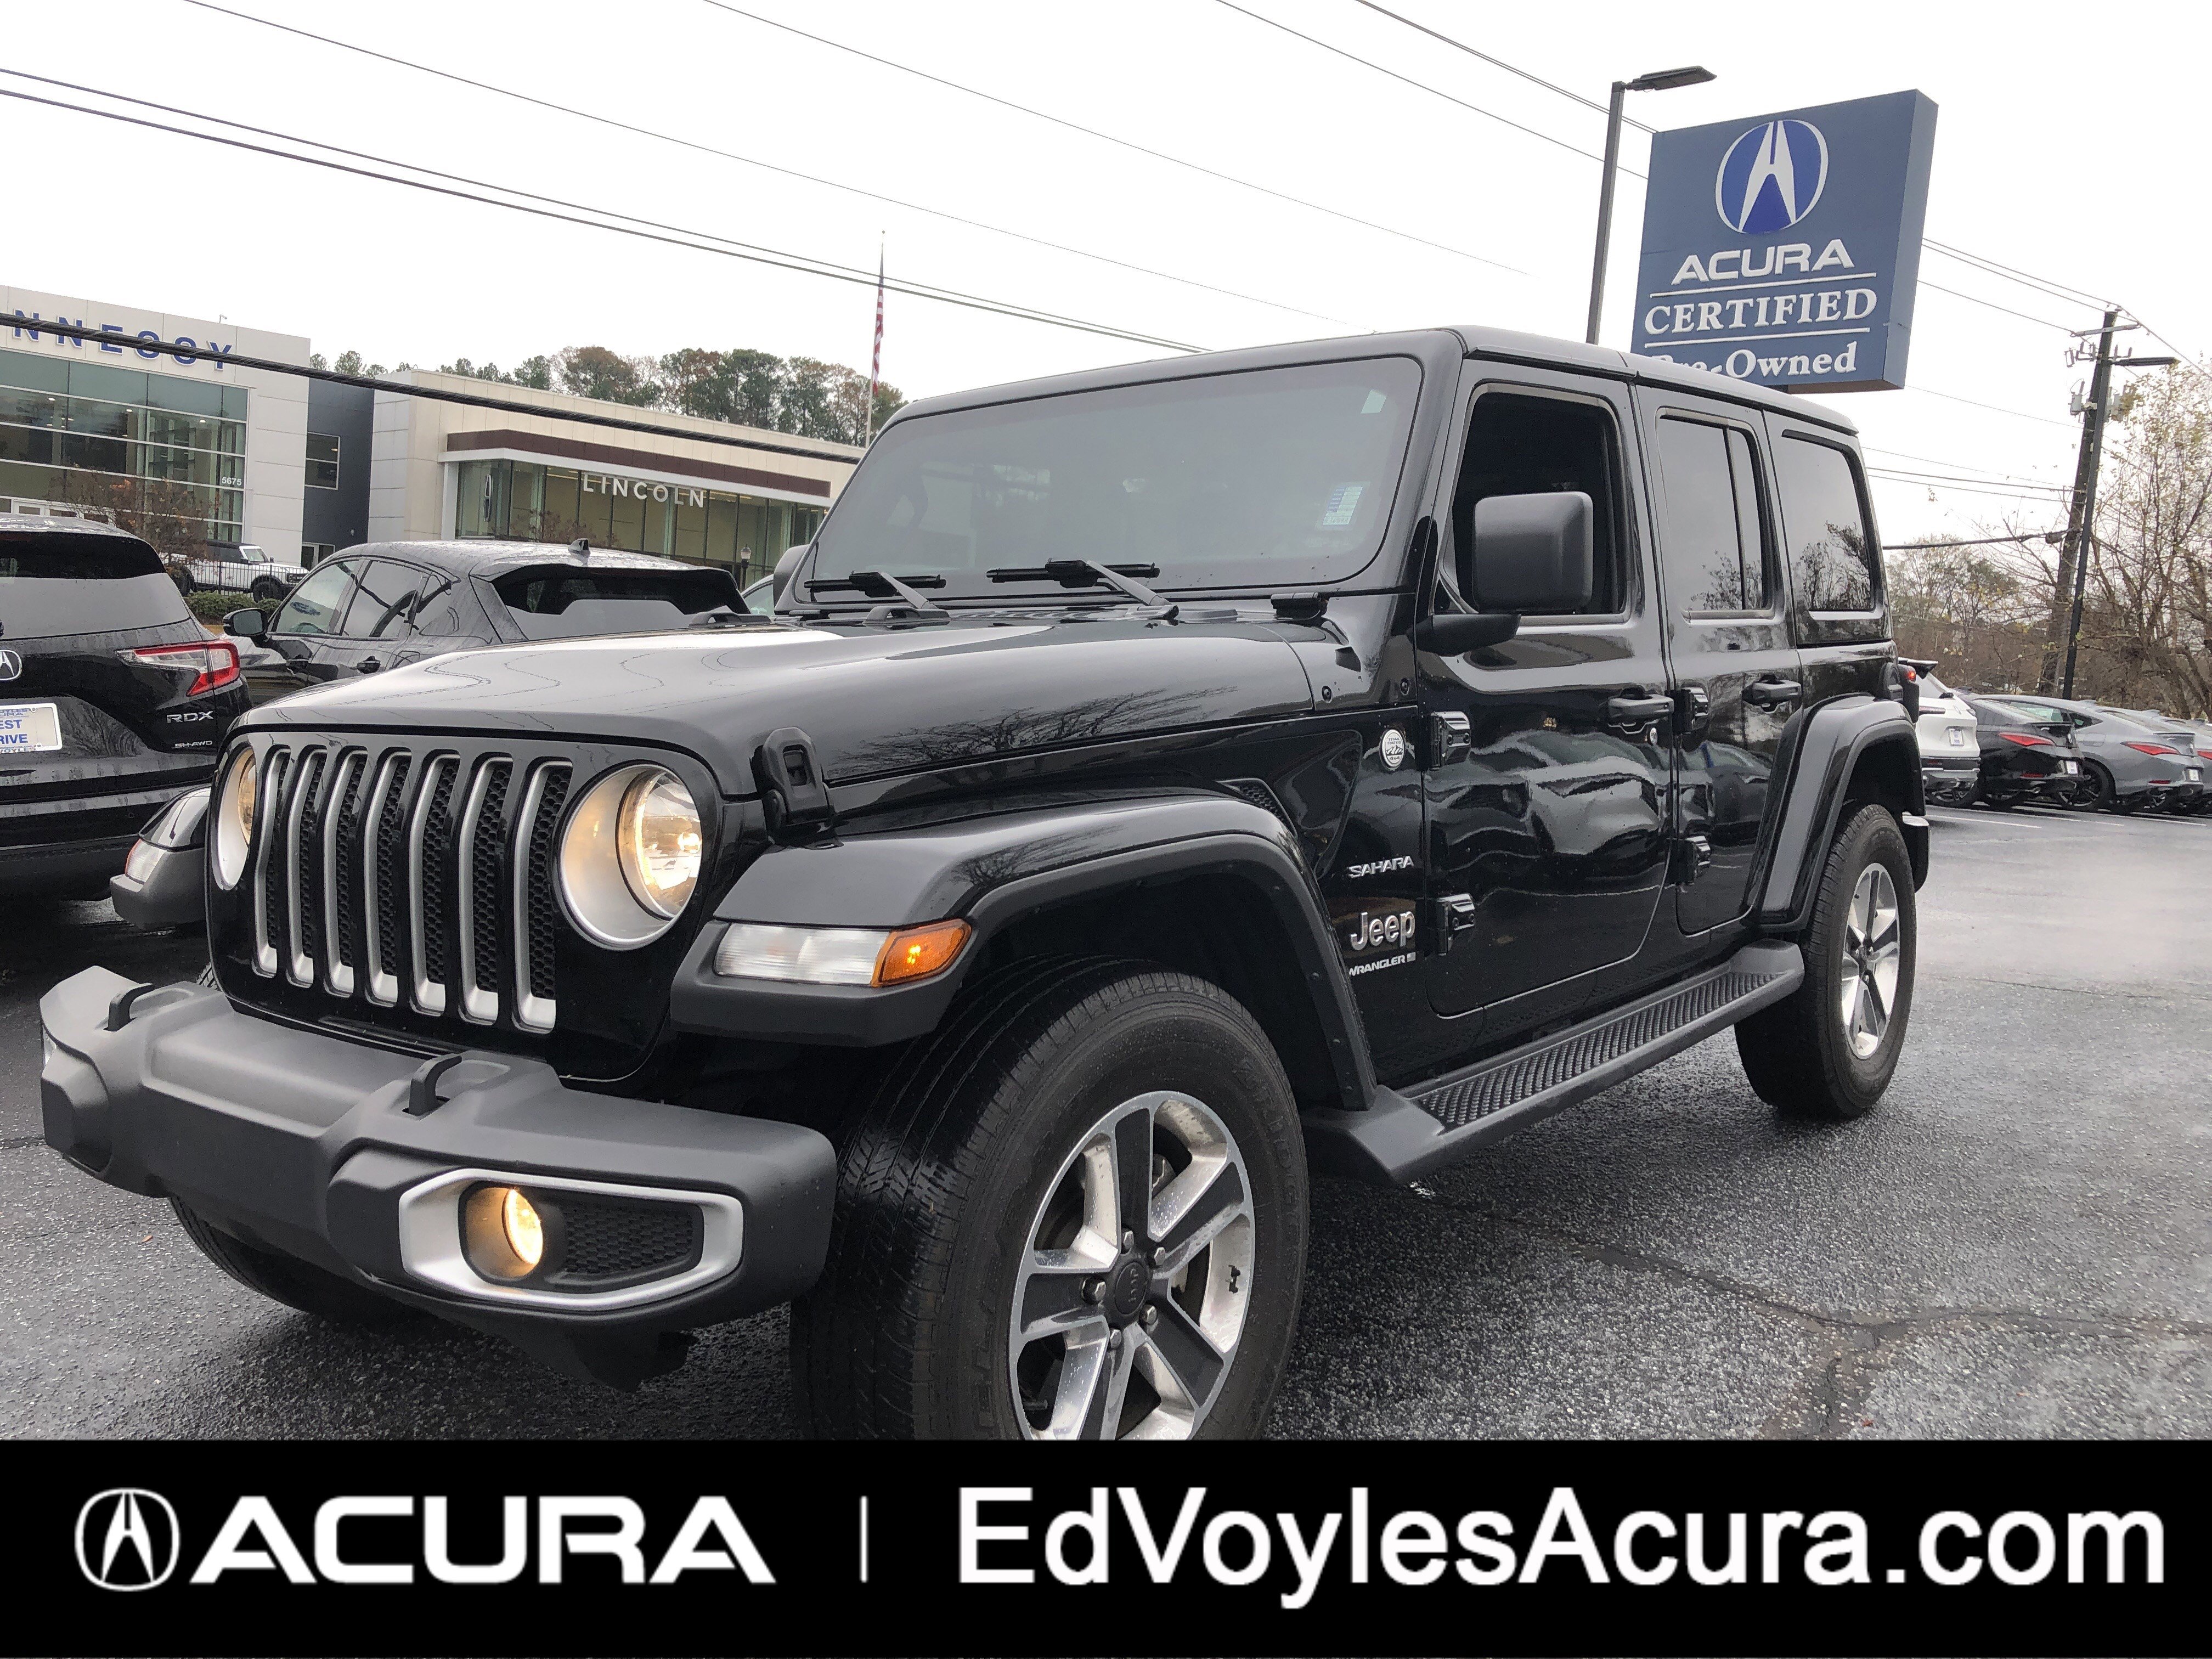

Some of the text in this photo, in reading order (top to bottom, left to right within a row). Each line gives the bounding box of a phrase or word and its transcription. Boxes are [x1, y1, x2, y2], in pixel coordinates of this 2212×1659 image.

[1671, 239, 1855, 285] ACURA
[1645, 288, 1877, 335] CERTIFIED
[222, 476, 242, 486] 5675
[583, 473, 704, 508] LINCOLN
[167, 710, 213, 723] RDX
[1348, 856, 1414, 878] SAHARA
[1350, 911, 1415, 950] Jeep
[1349, 955, 1406, 976] WRANGLER
